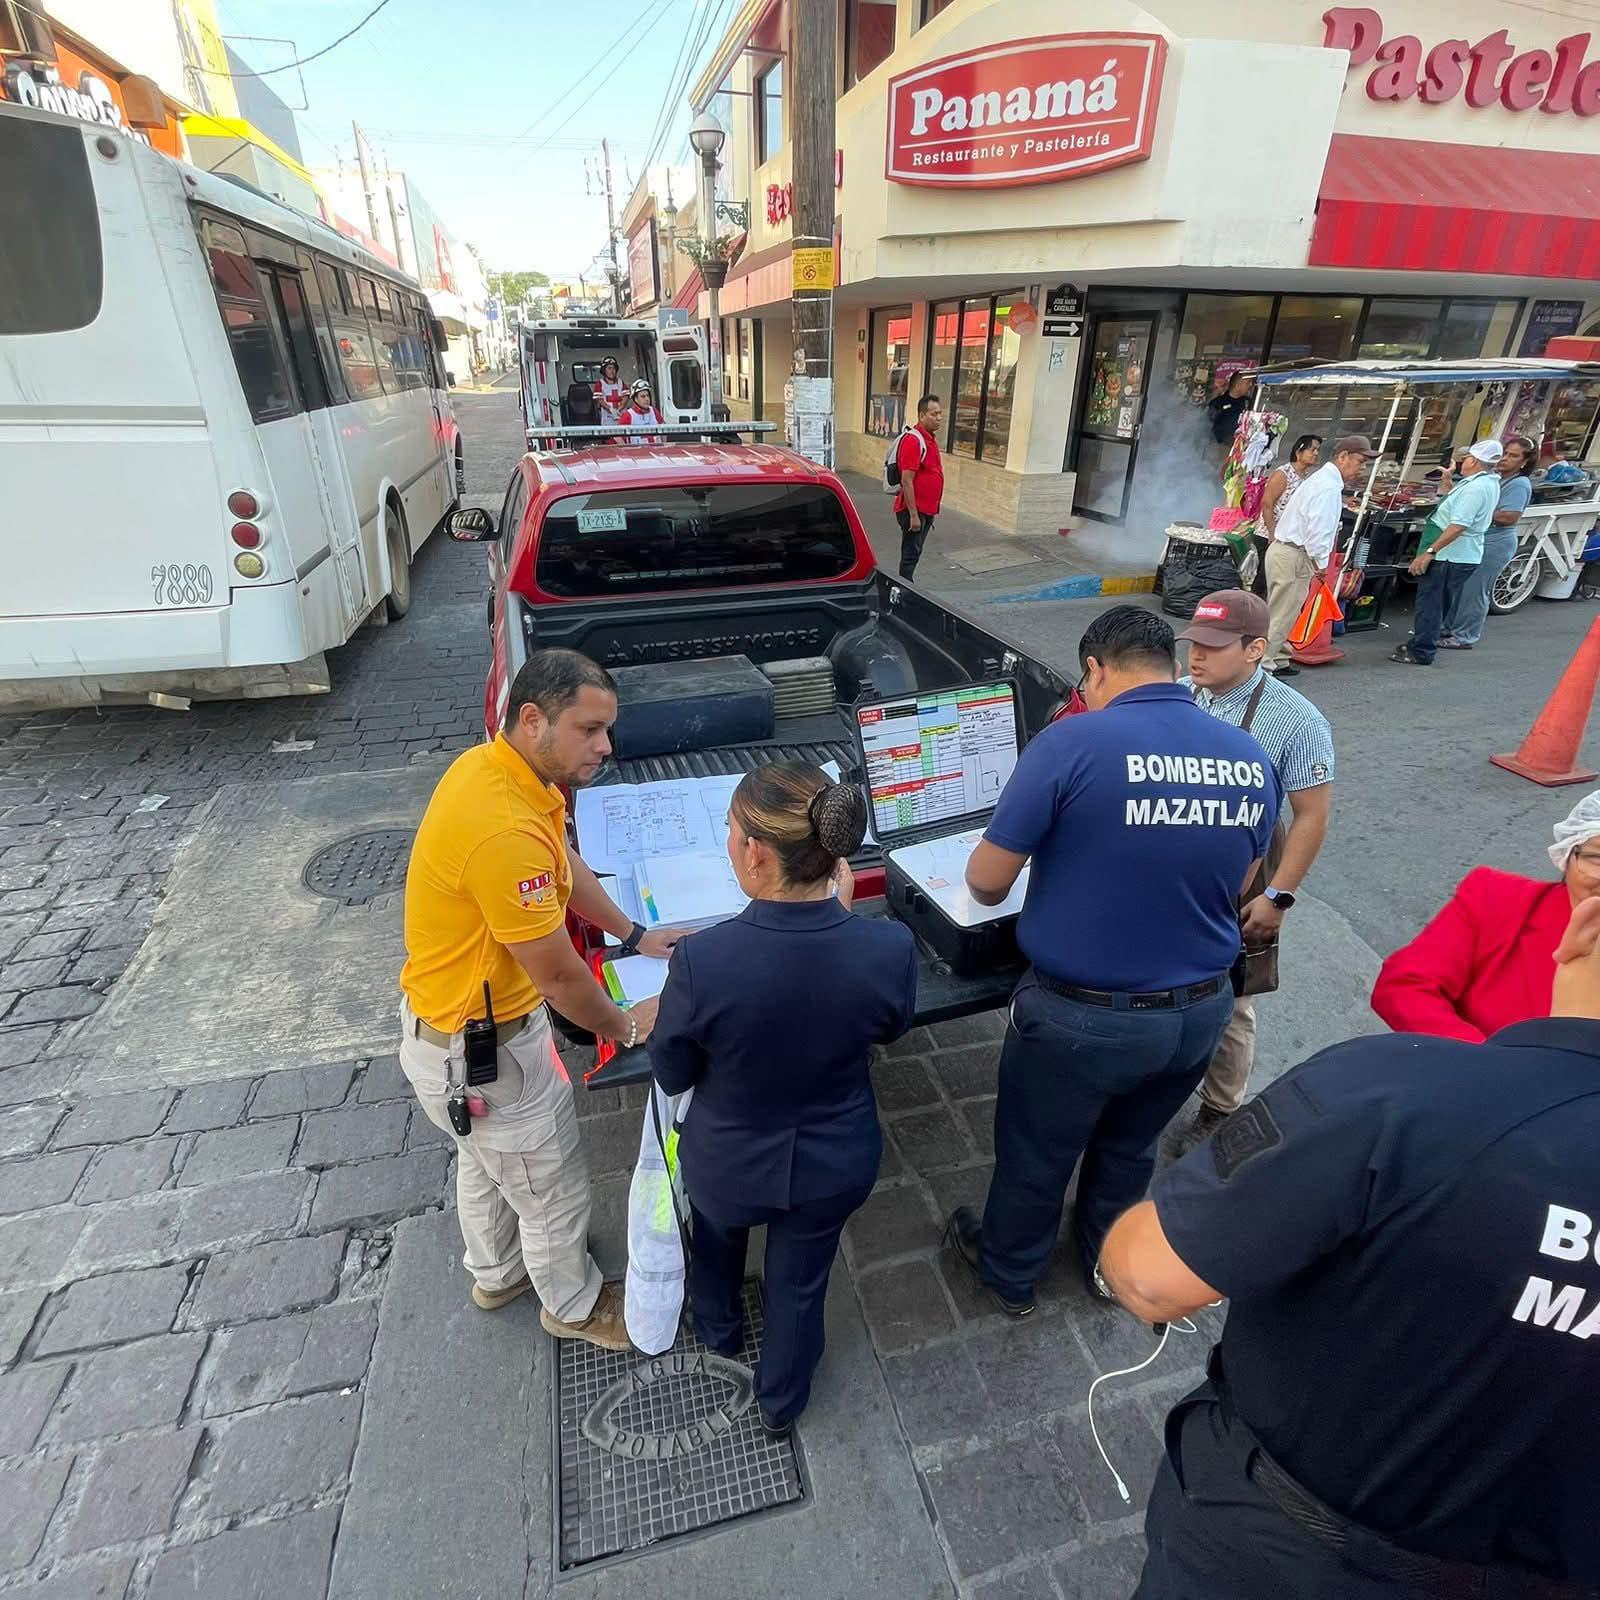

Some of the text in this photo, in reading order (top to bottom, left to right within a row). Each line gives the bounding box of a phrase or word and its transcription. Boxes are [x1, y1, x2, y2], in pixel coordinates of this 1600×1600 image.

[909, 58, 1118, 136] Panamá
[912, 131, 1110, 166] Restaurante y Pastelería
[151, 563, 213, 605] 7889
[632, 628, 819, 661] MITSUBISHI MOTORS
[1126, 754, 1265, 789] BOMBEROS
[1125, 795, 1265, 828] MAZATLÁN
[520, 873, 550, 892] 911
[1539, 1203, 1600, 1267] B
[631, 1354, 706, 1391] AGUA
[610, 1403, 740, 1457] POTABLE
